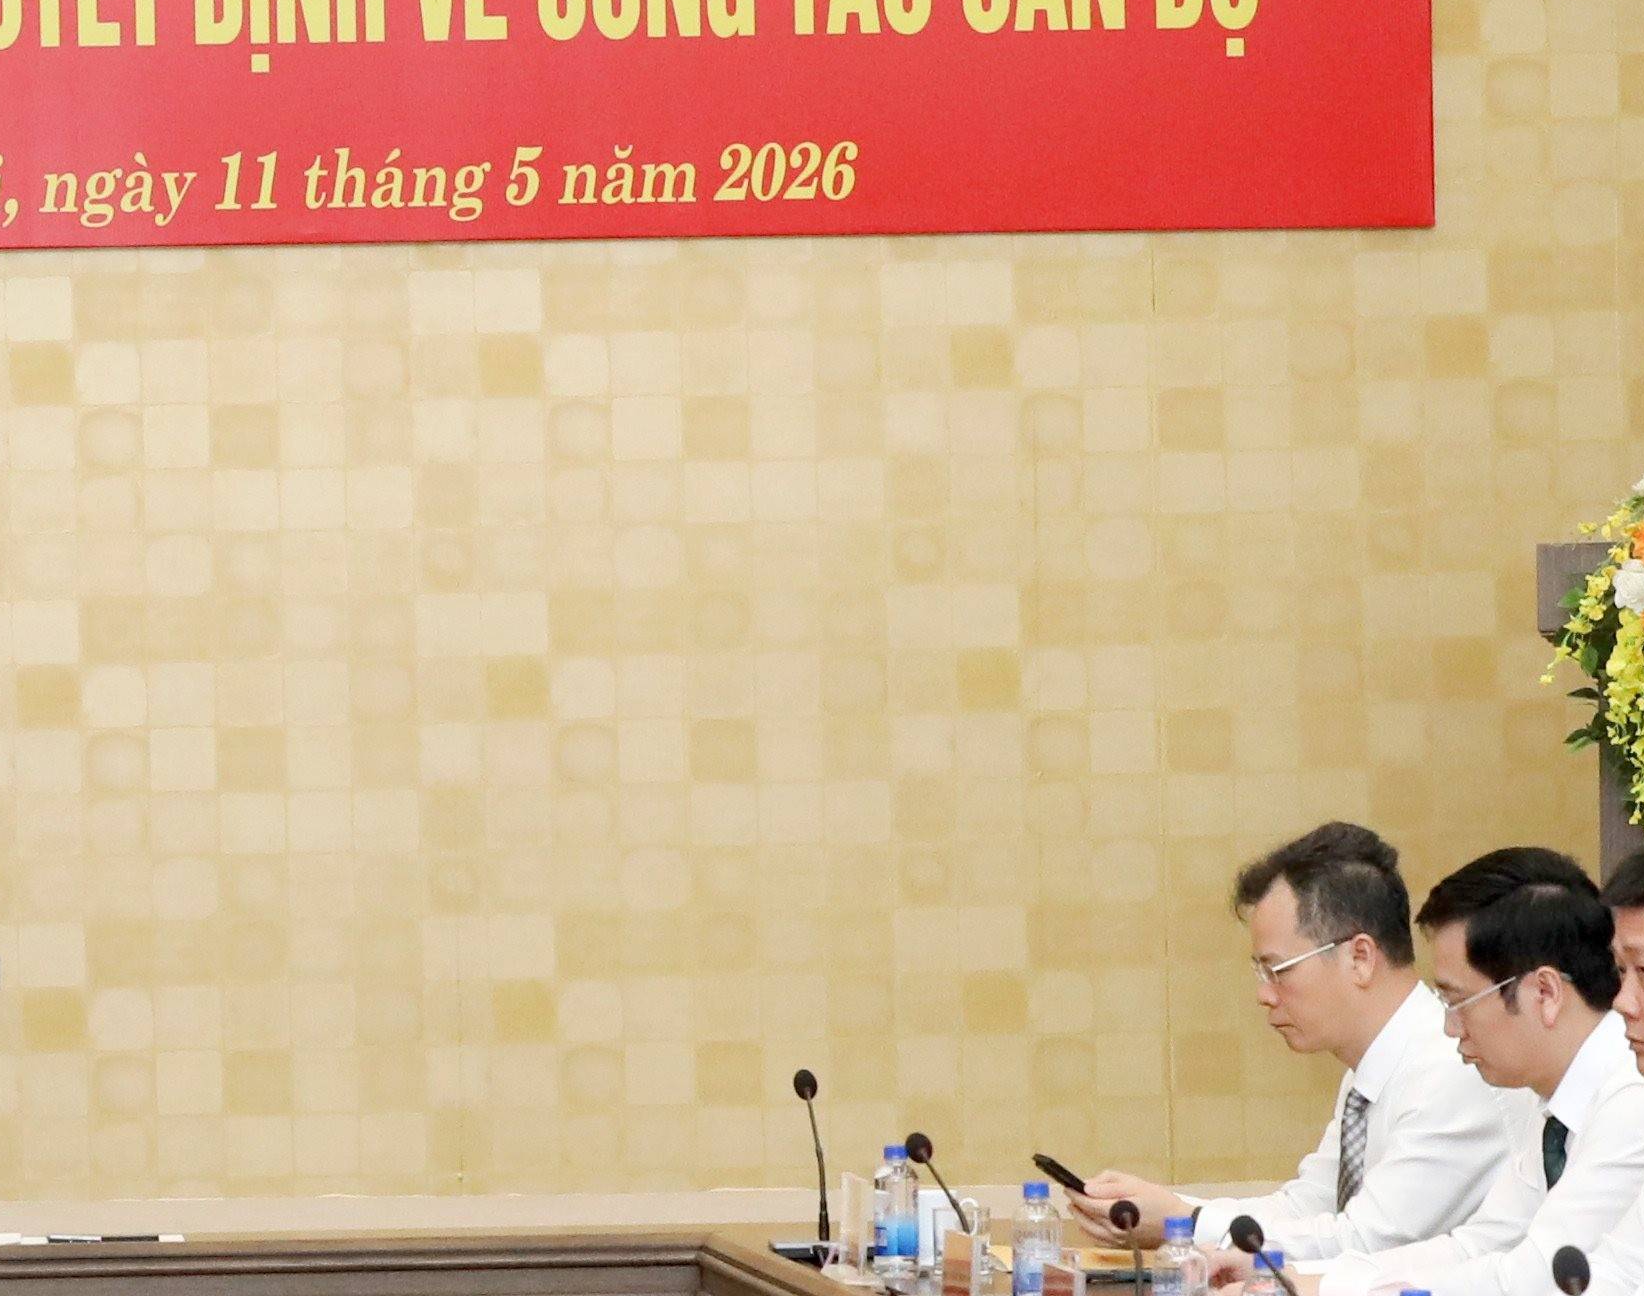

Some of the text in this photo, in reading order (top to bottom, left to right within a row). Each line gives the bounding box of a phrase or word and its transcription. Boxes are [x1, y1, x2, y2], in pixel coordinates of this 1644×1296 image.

[38, 151, 197, 228] ngày
[214, 151, 278, 210] 11
[303, 147, 492, 222] tháng
[505, 146, 543, 206] 5
[557, 144, 697, 205] năm
[713, 141, 859, 202] 2026
